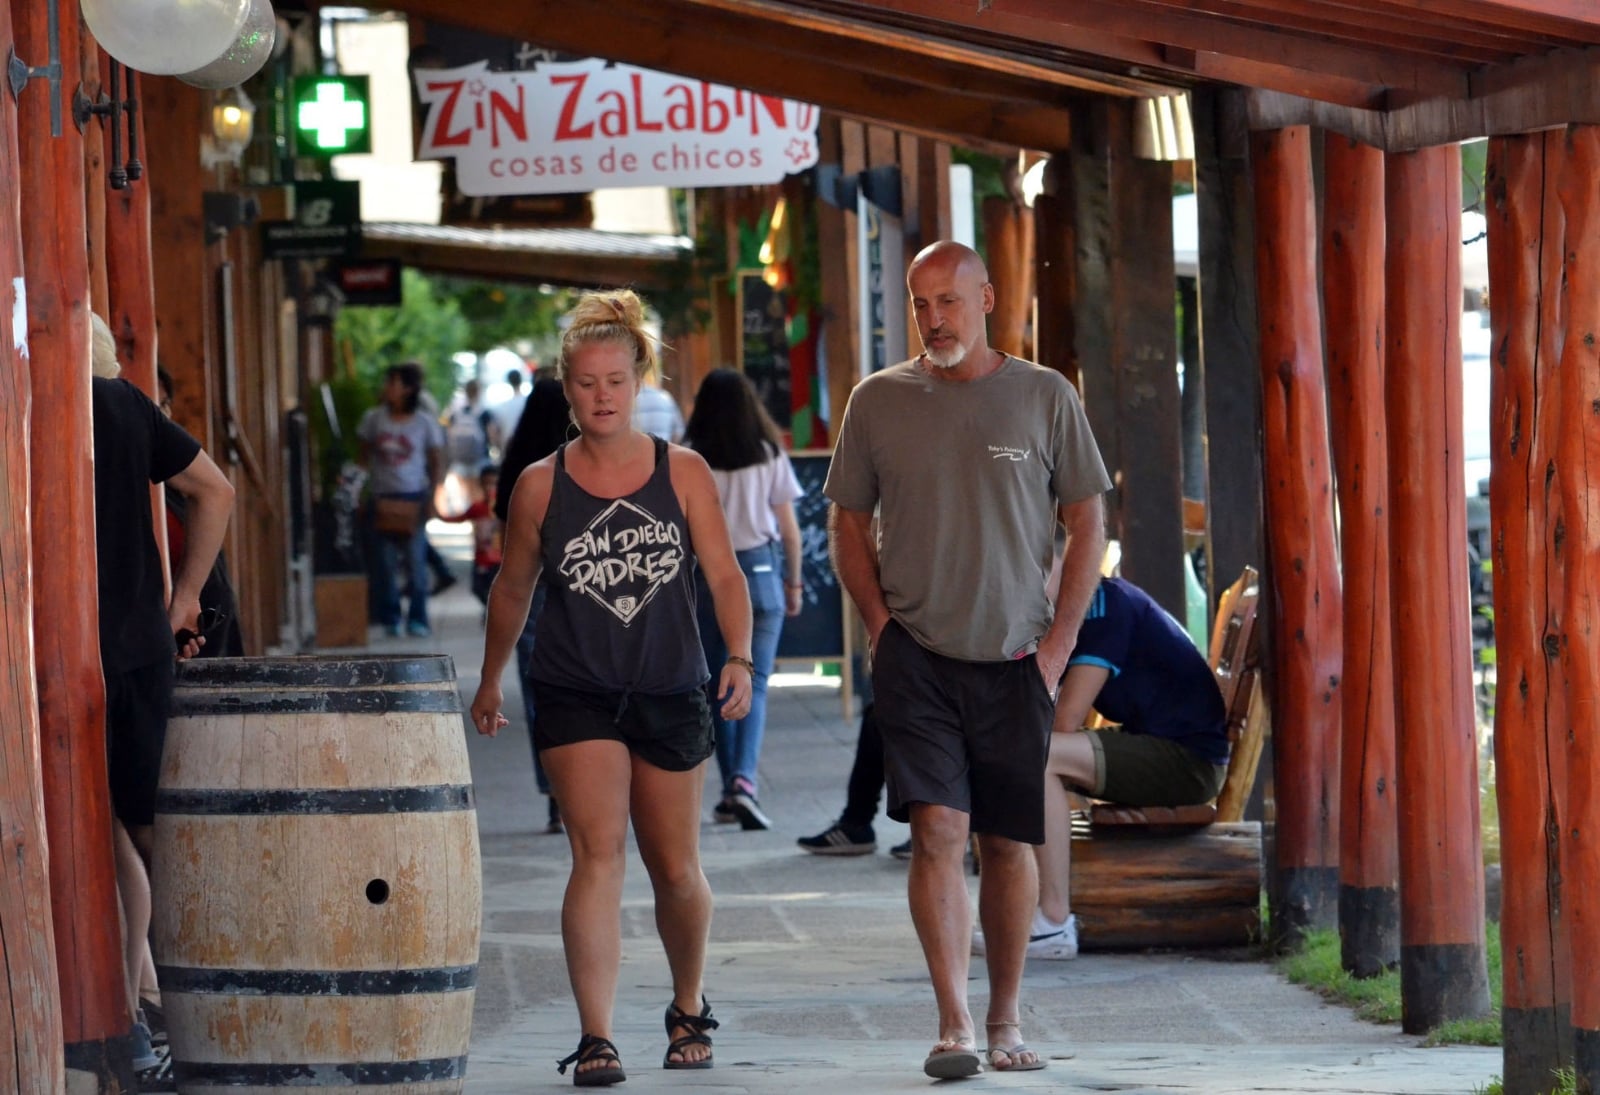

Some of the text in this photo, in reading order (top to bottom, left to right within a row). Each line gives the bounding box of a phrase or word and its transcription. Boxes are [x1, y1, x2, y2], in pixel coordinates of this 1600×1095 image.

[489, 144, 764, 178] cosas de chicos
[564, 521, 681, 559] SAN DIEGO
[568, 549, 681, 595] PADRES
